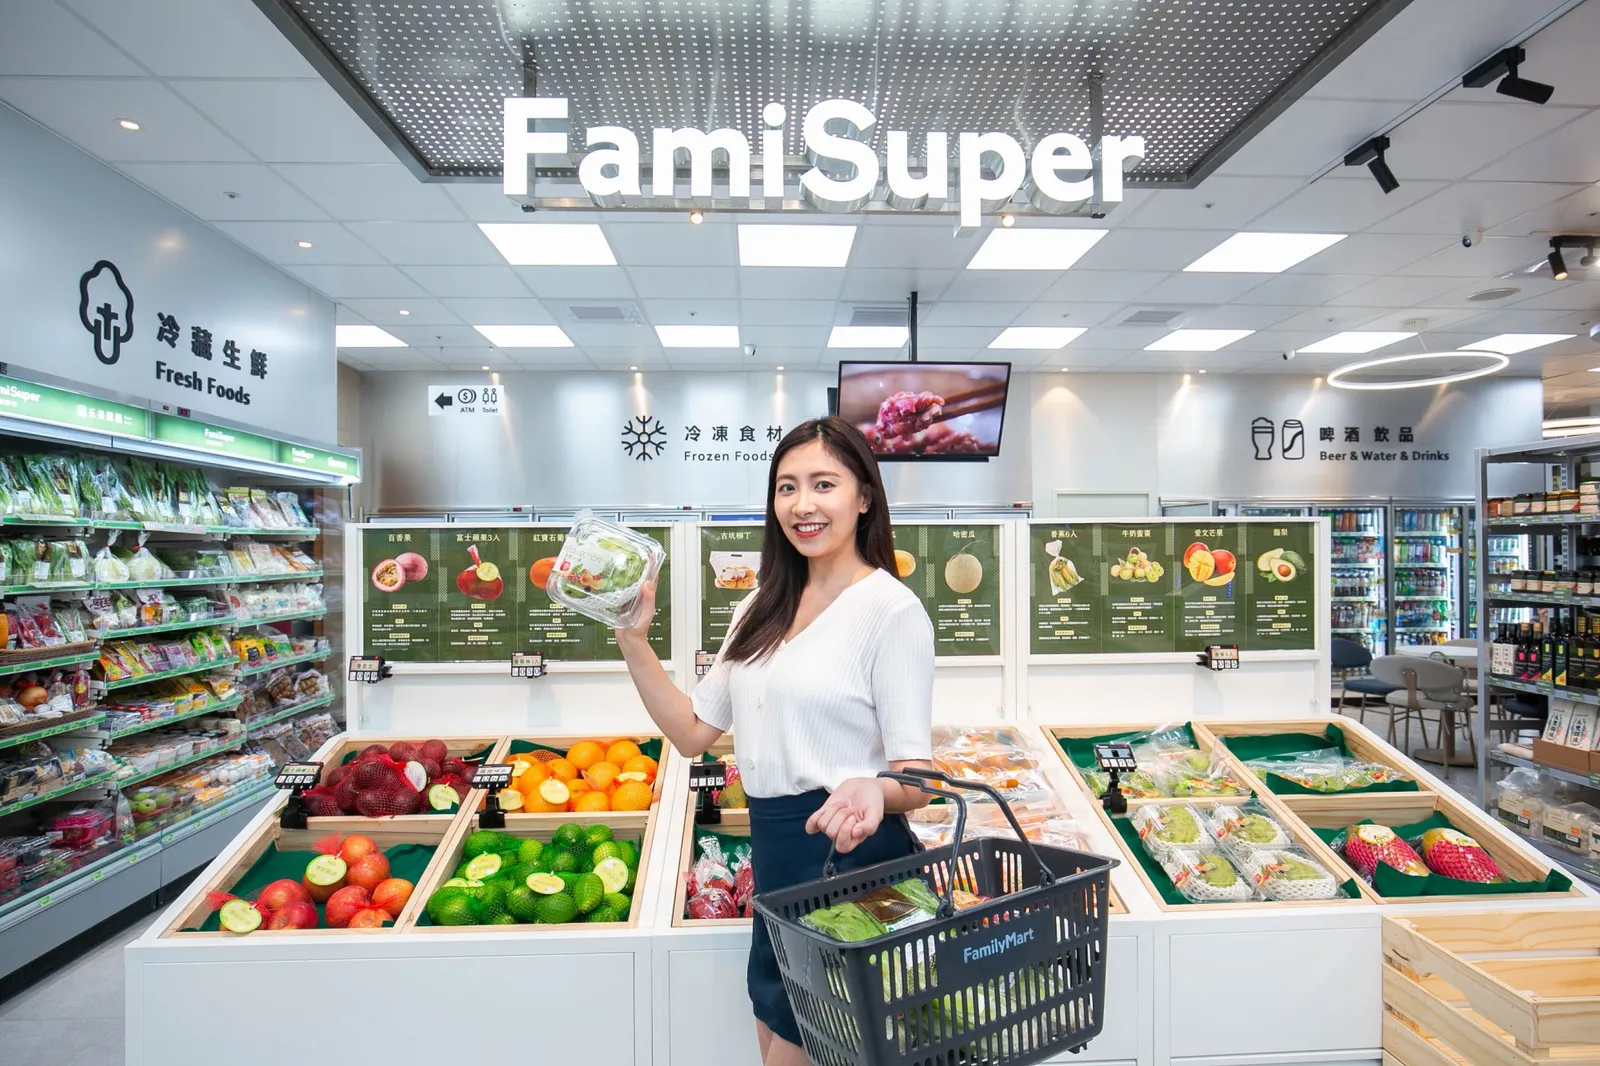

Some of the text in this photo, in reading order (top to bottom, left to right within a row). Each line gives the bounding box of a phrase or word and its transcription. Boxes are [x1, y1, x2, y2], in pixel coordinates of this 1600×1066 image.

[503, 97, 1144, 228] FamiSuper
[157, 312, 268, 379] 冷藏生鮮
[156, 361, 251, 406] Fresh Foods
[685, 425, 783, 442] 冷凍食材
[684, 450, 774, 461] Frozen Foods
[1320, 450, 1450, 462] Beer & Water & Drinks
[387, 533, 412, 542] 百香果
[952, 530, 976, 539] 哈密瓜
[963, 927, 1035, 964] FamilyMart
